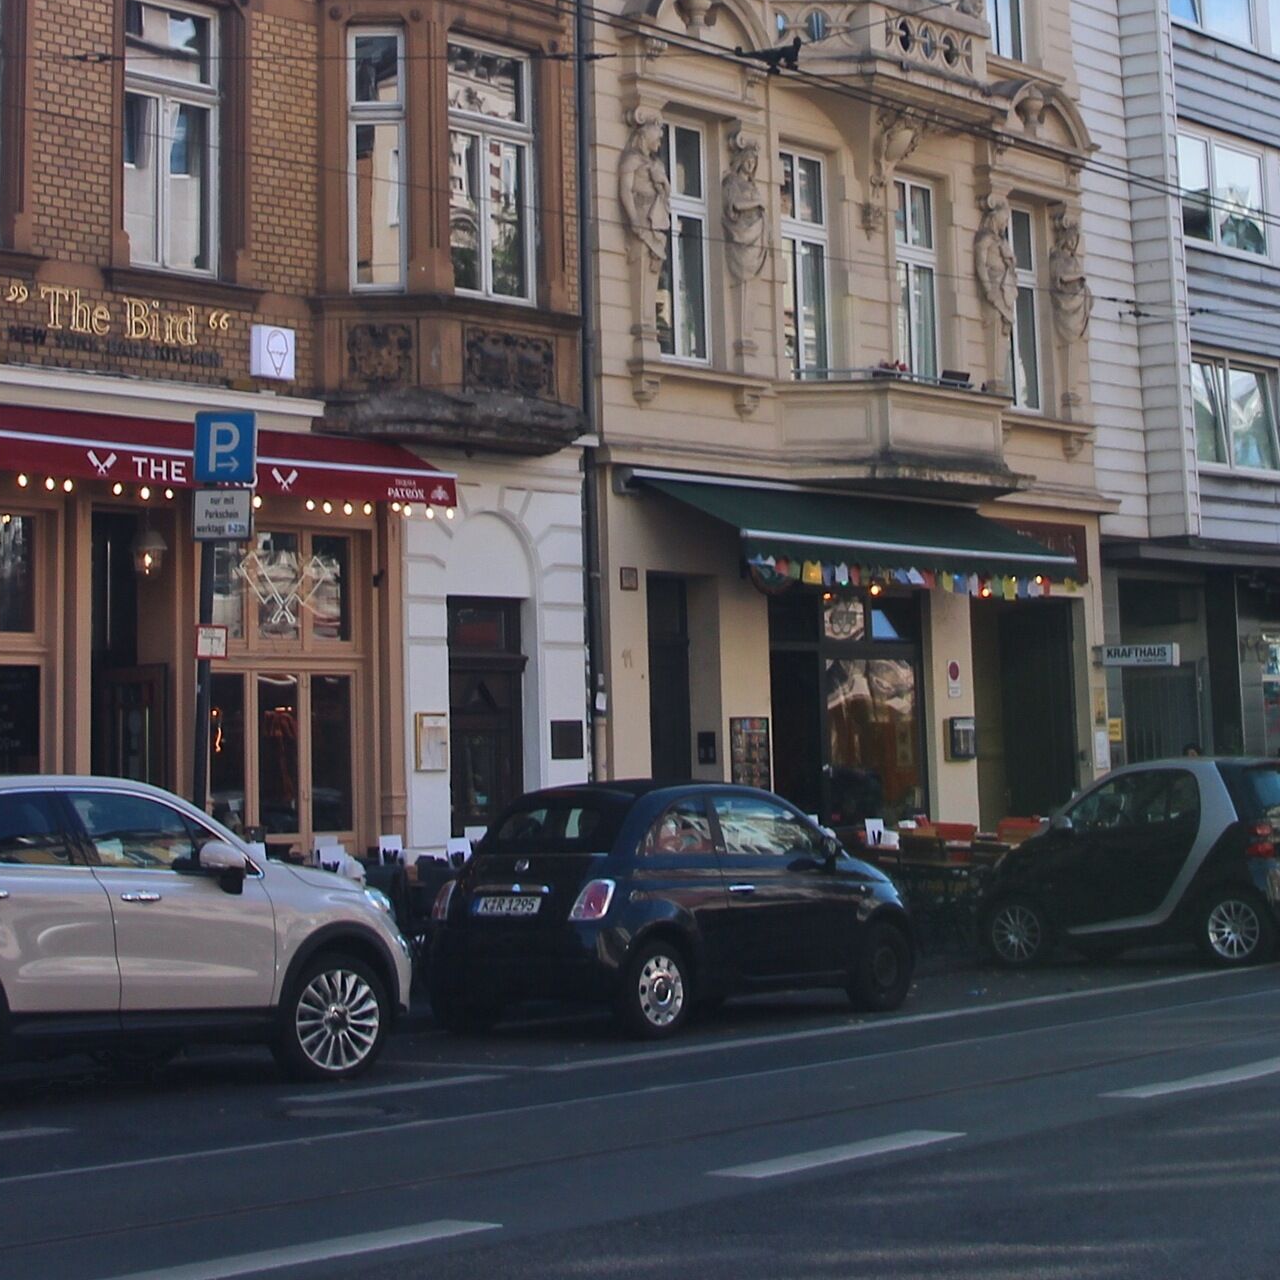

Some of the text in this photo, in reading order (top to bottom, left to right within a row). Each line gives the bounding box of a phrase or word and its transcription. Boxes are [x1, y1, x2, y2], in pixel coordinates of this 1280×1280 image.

[41, 286, 111, 336] The
[123, 295, 198, 346] Bird
[208, 421, 240, 473] P
[132, 455, 187, 483] THE
[1106, 647, 1167, 659] KRAFTHAUS
